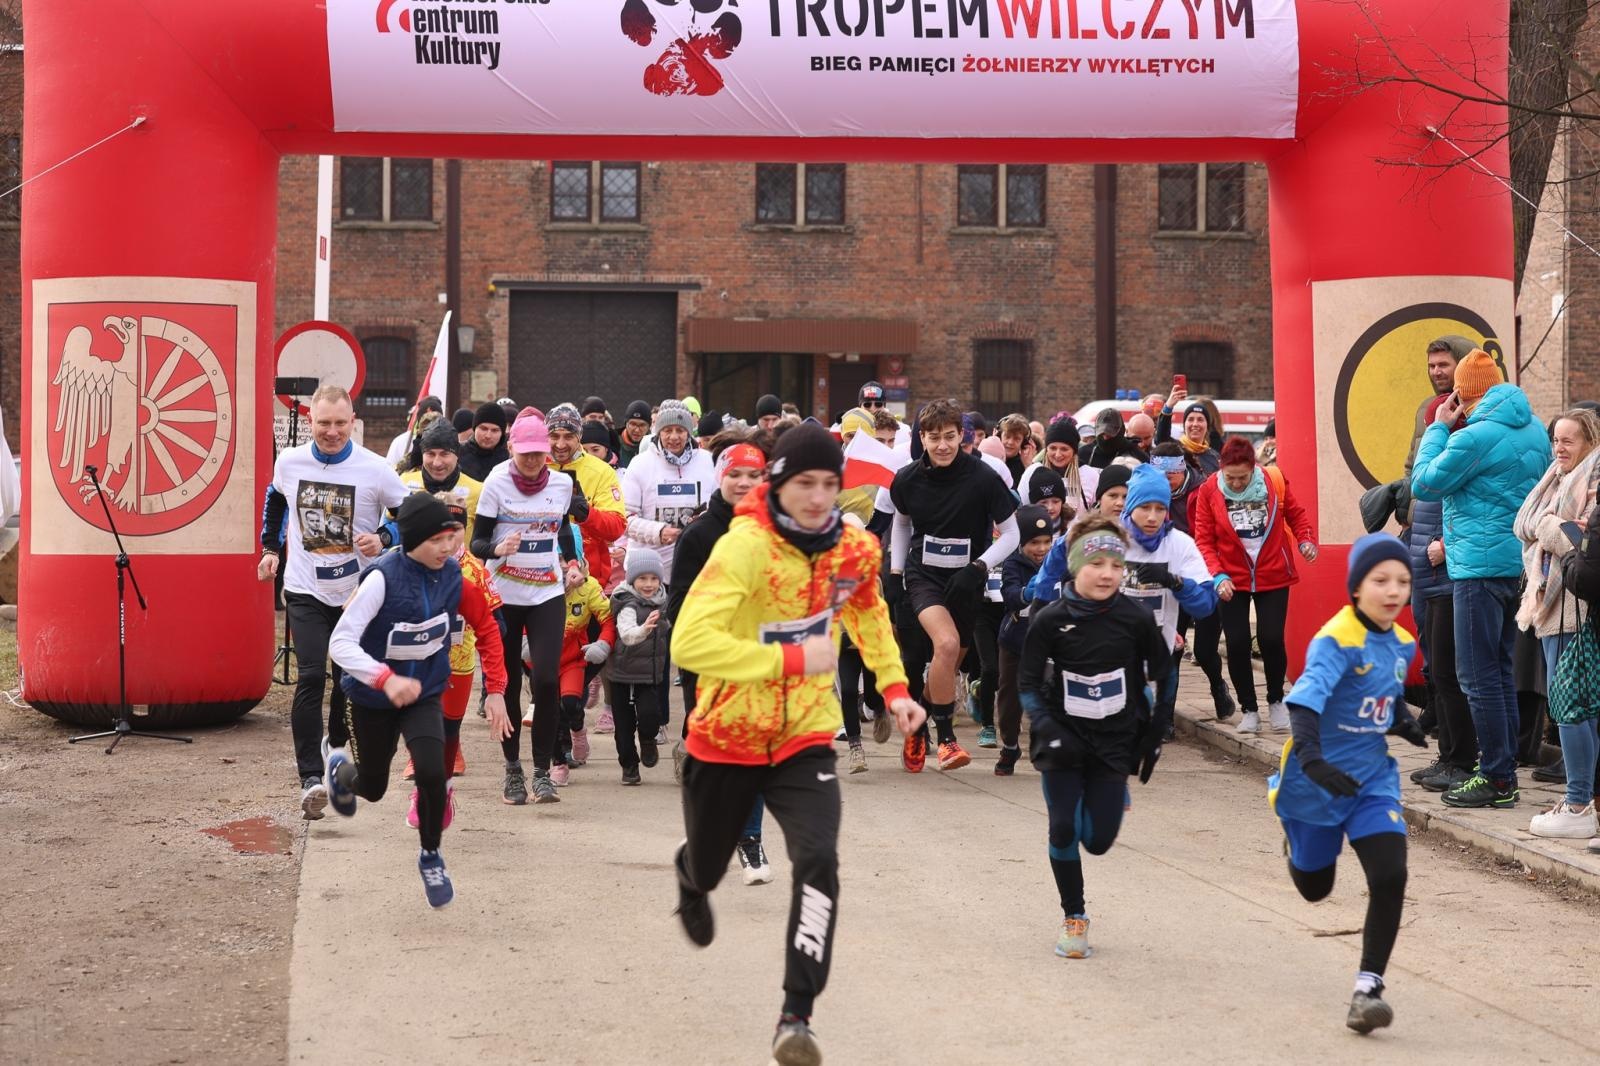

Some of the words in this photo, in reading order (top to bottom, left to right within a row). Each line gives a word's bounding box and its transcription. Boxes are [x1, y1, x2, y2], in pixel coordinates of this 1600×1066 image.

[413, 5, 499, 34] entrum
[415, 35, 501, 71] Kultury
[810, 56, 862, 71] BIEG
[869, 57, 955, 76] PAMIĘCI
[962, 54, 1082, 73] ŻOŁNIERZY
[1088, 58, 1215, 77] WYKLĘTYCH
[672, 485, 681, 493] 20
[528, 542, 538, 551] 17
[332, 567, 344, 577] 39
[413, 632, 429, 642] 40
[794, 883, 832, 963] NIKE
